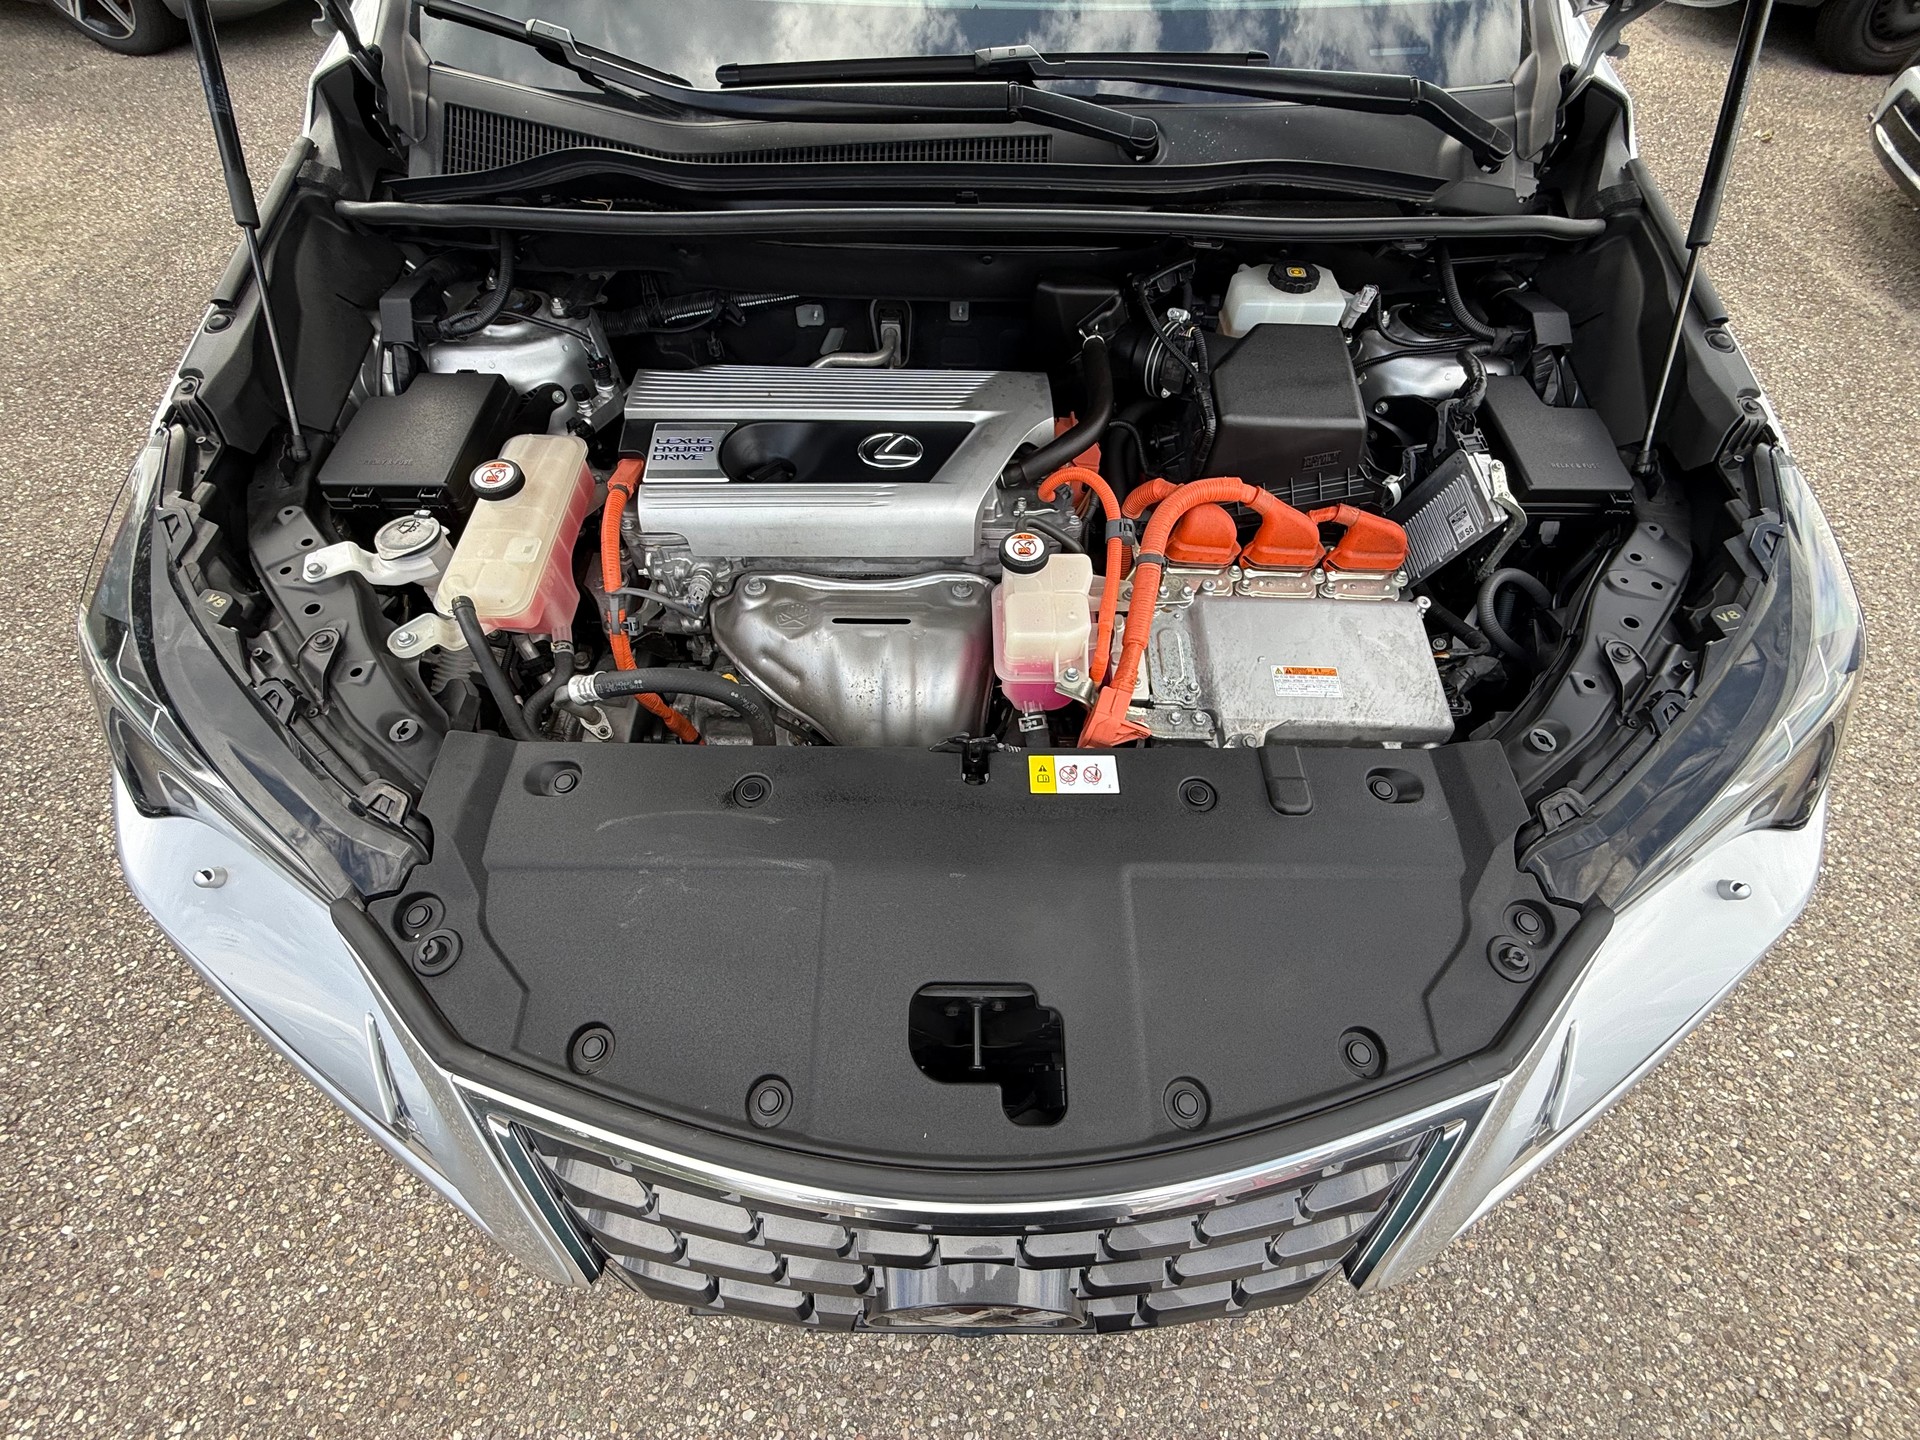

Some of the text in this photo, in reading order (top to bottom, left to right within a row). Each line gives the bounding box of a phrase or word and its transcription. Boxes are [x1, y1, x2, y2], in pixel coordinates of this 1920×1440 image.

[656, 437, 712, 445] LEXUS
[654, 445, 714, 453] HYBRID
[1464, 525, 1474, 536] S6
[1716, 610, 1741, 622] V8
